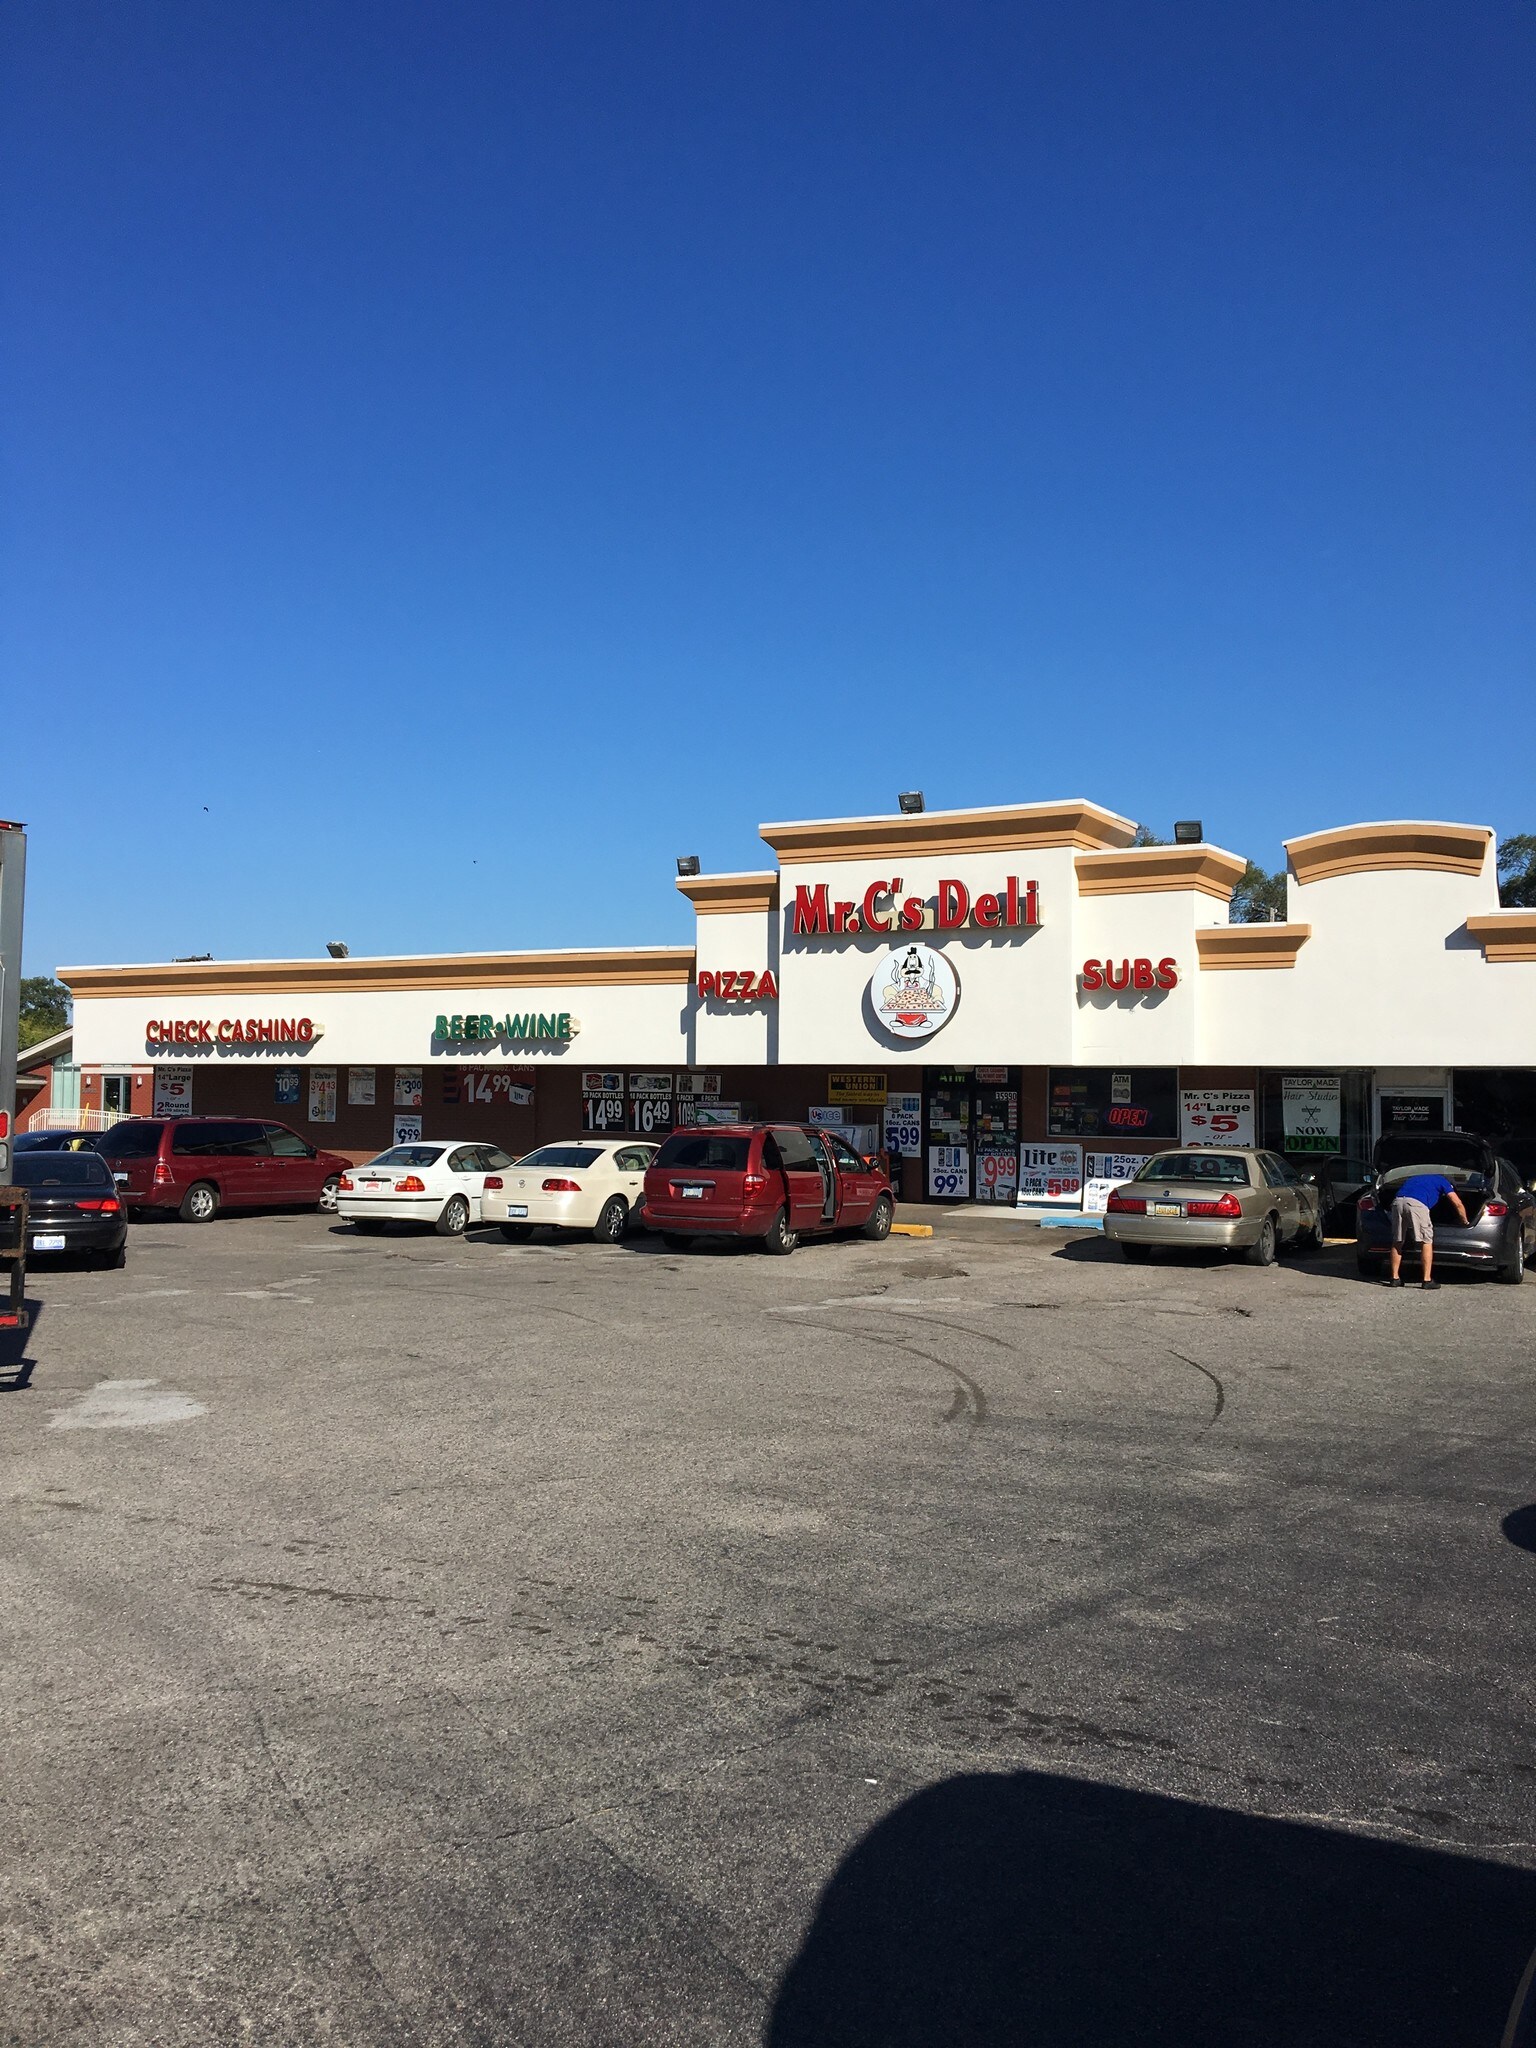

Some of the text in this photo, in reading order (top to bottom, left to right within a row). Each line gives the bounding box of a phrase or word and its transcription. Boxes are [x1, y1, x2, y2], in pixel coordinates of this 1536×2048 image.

[938, 876, 1040, 929] Deli
[1082, 957, 1178, 991] SUBS
[698, 970, 778, 999] PIZZA
[146, 1018, 313, 1043] CHECK CASHING
[435, 1013, 571, 1039] BEER WINE
[1284, 1078, 1339, 1087] TAYLOR MADE
[995, 1091, 1017, 1101] 35990
[1284, 1091, 1339, 1101] Hair Studio
[156, 1101, 164, 1112] 2
[1108, 1107, 1149, 1127] OPEN
[1190, 1114, 1239, 1133] $5
[1295, 1126, 1328, 1135] NOW
[1287, 1136, 1338, 1151] OPEN
[1023, 1149, 1057, 1169] Lite
[1113, 1155, 1139, 1164] 25oz.
[1029, 1177, 1042, 1187] PACK
[1031, 1187, 1045, 1197] CANS
